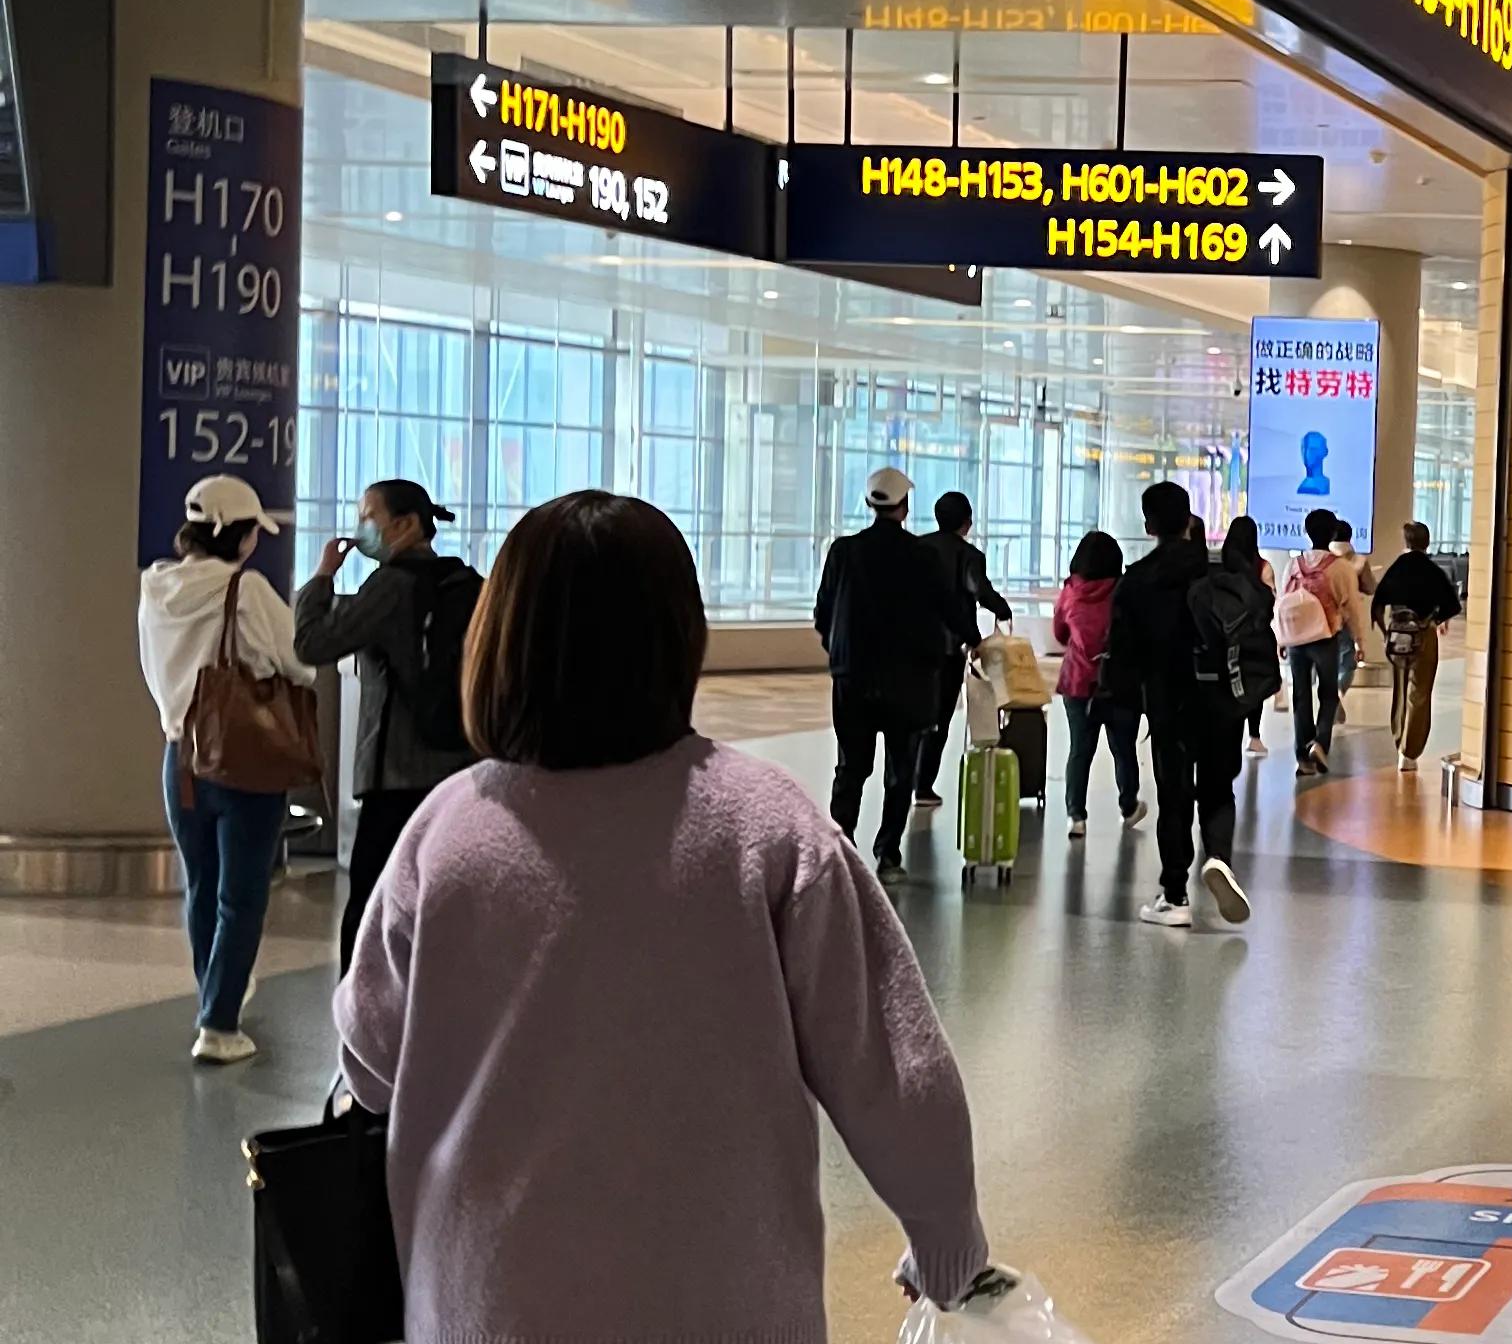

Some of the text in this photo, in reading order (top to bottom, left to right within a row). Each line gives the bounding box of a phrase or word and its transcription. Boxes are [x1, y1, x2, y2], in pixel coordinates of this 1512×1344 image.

[501, 79, 627, 154] H171-H190
[165, 168, 284, 238] H170
[588, 165, 630, 222] 190,
[633, 176, 669, 224] 152
[862, 157, 1250, 208] H148-H153, H601-H602
[1047, 218, 1248, 262] H154-H169
[161, 252, 282, 319] H190
[166, 358, 206, 387] VIP
[1256, 339, 1373, 363] 做正确的战略
[1256, 366, 1374, 399] 找特劳特
